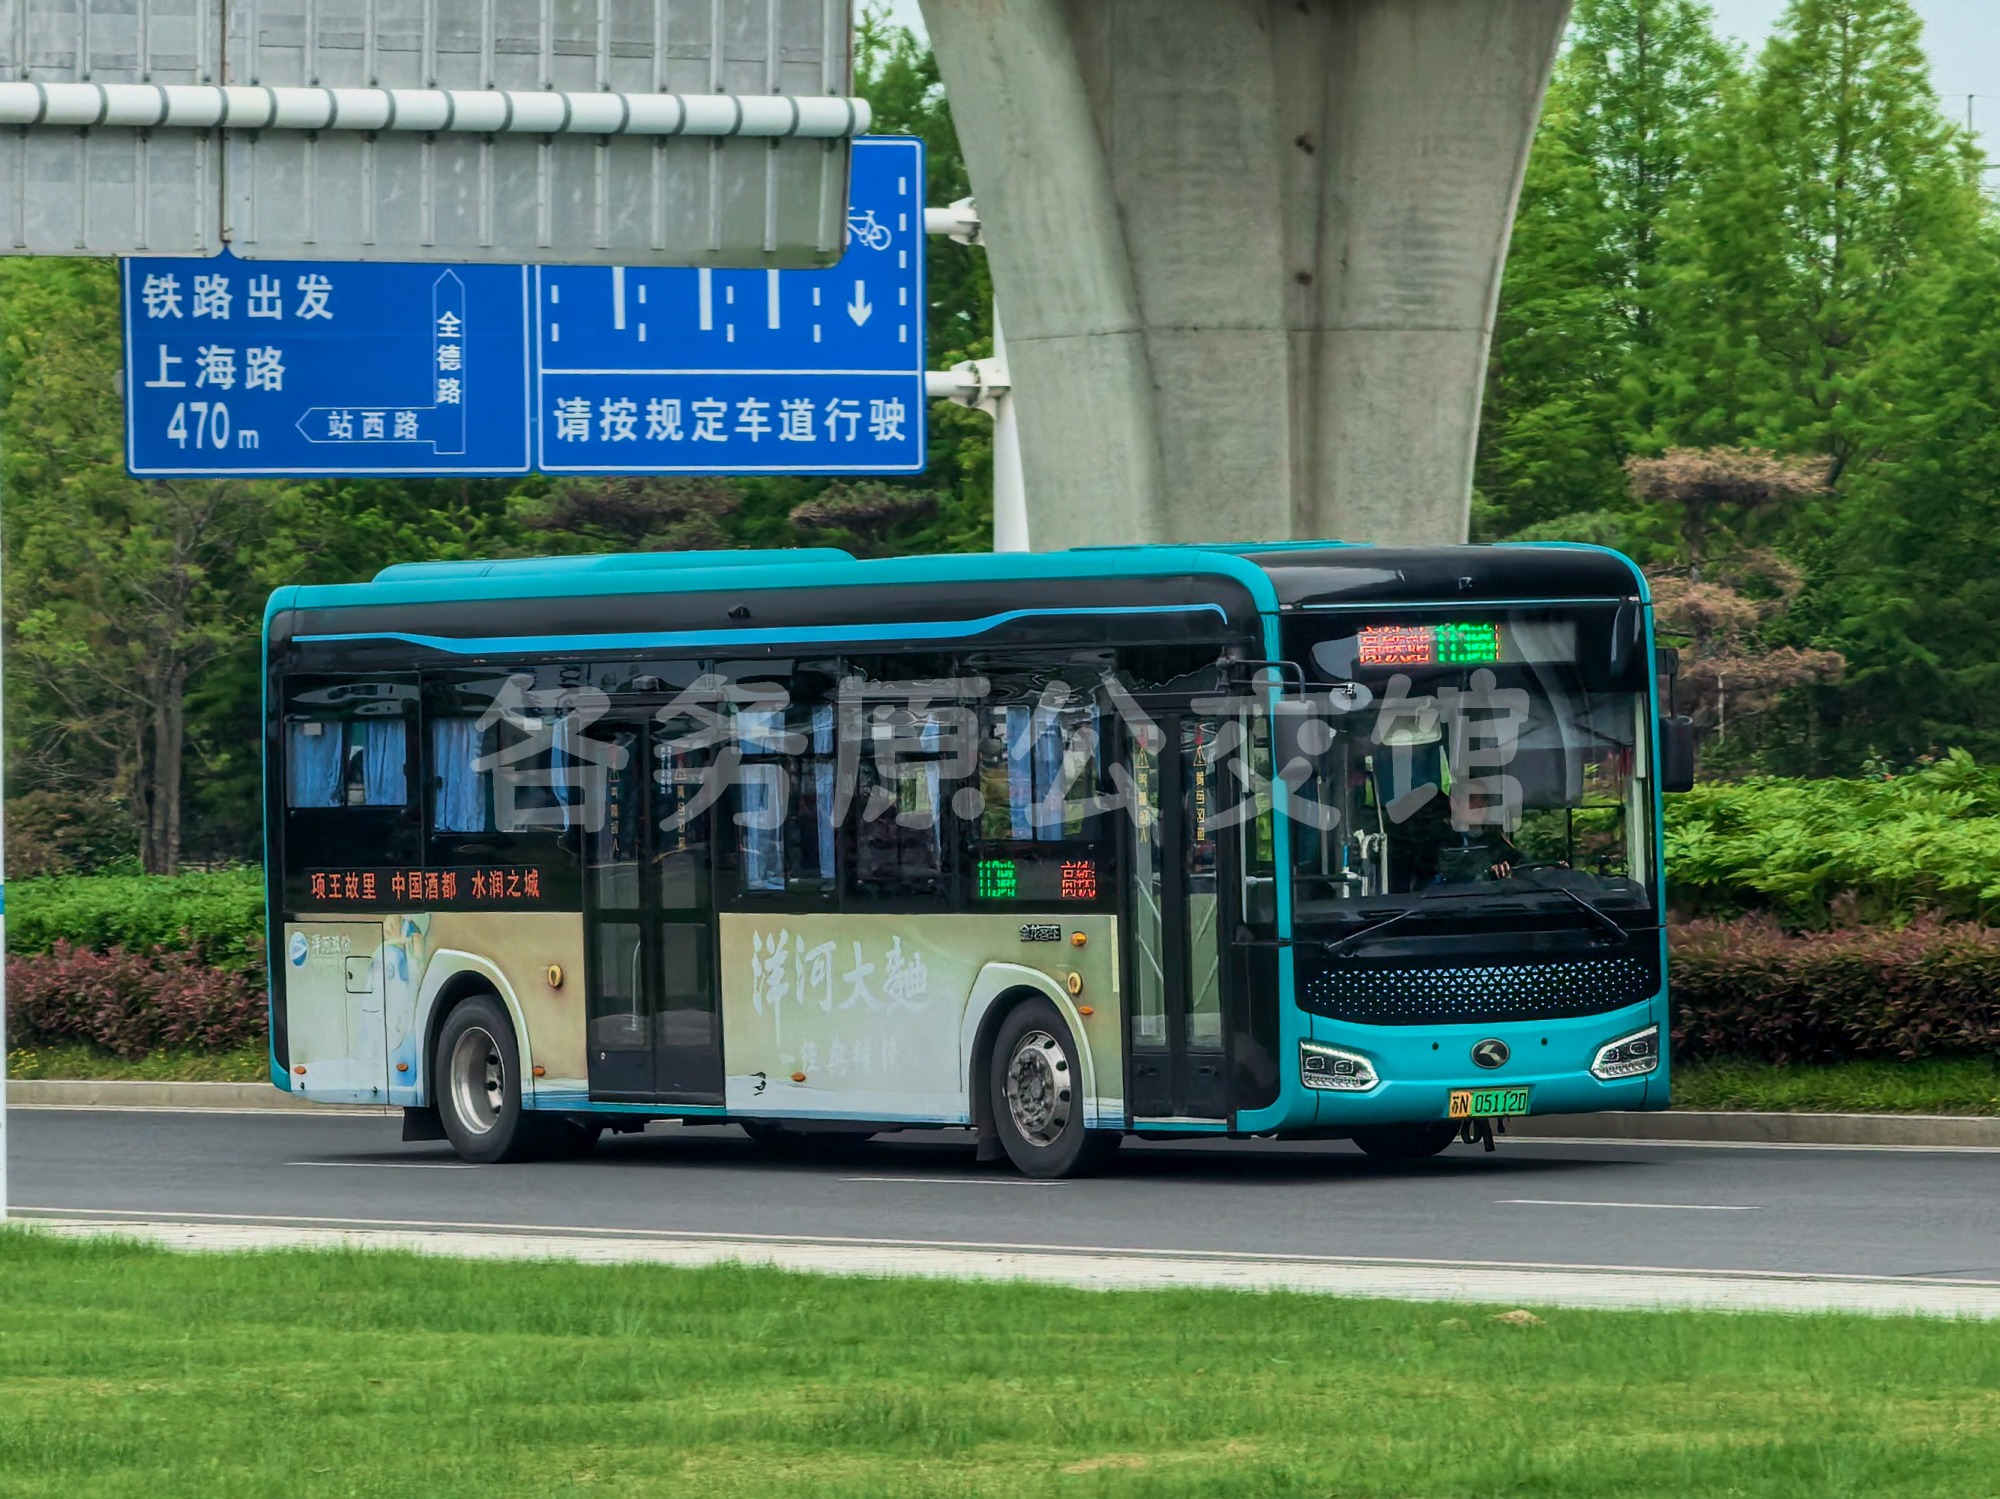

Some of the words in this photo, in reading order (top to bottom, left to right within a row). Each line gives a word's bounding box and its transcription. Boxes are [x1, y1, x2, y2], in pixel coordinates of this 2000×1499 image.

[141, 273, 334, 321] 铁路出发
[145, 344, 286, 392] 上海路
[436, 311, 463, 404] 全德路
[167, 401, 230, 450] 470
[237, 428, 260, 450] m
[328, 409, 420, 441] 站西路
[553, 396, 906, 443] 请按规定车道行驶
[311, 872, 377, 900] 项王故里
[391, 870, 457, 901] 中国酒都
[471, 868, 541, 899] 水润之城
